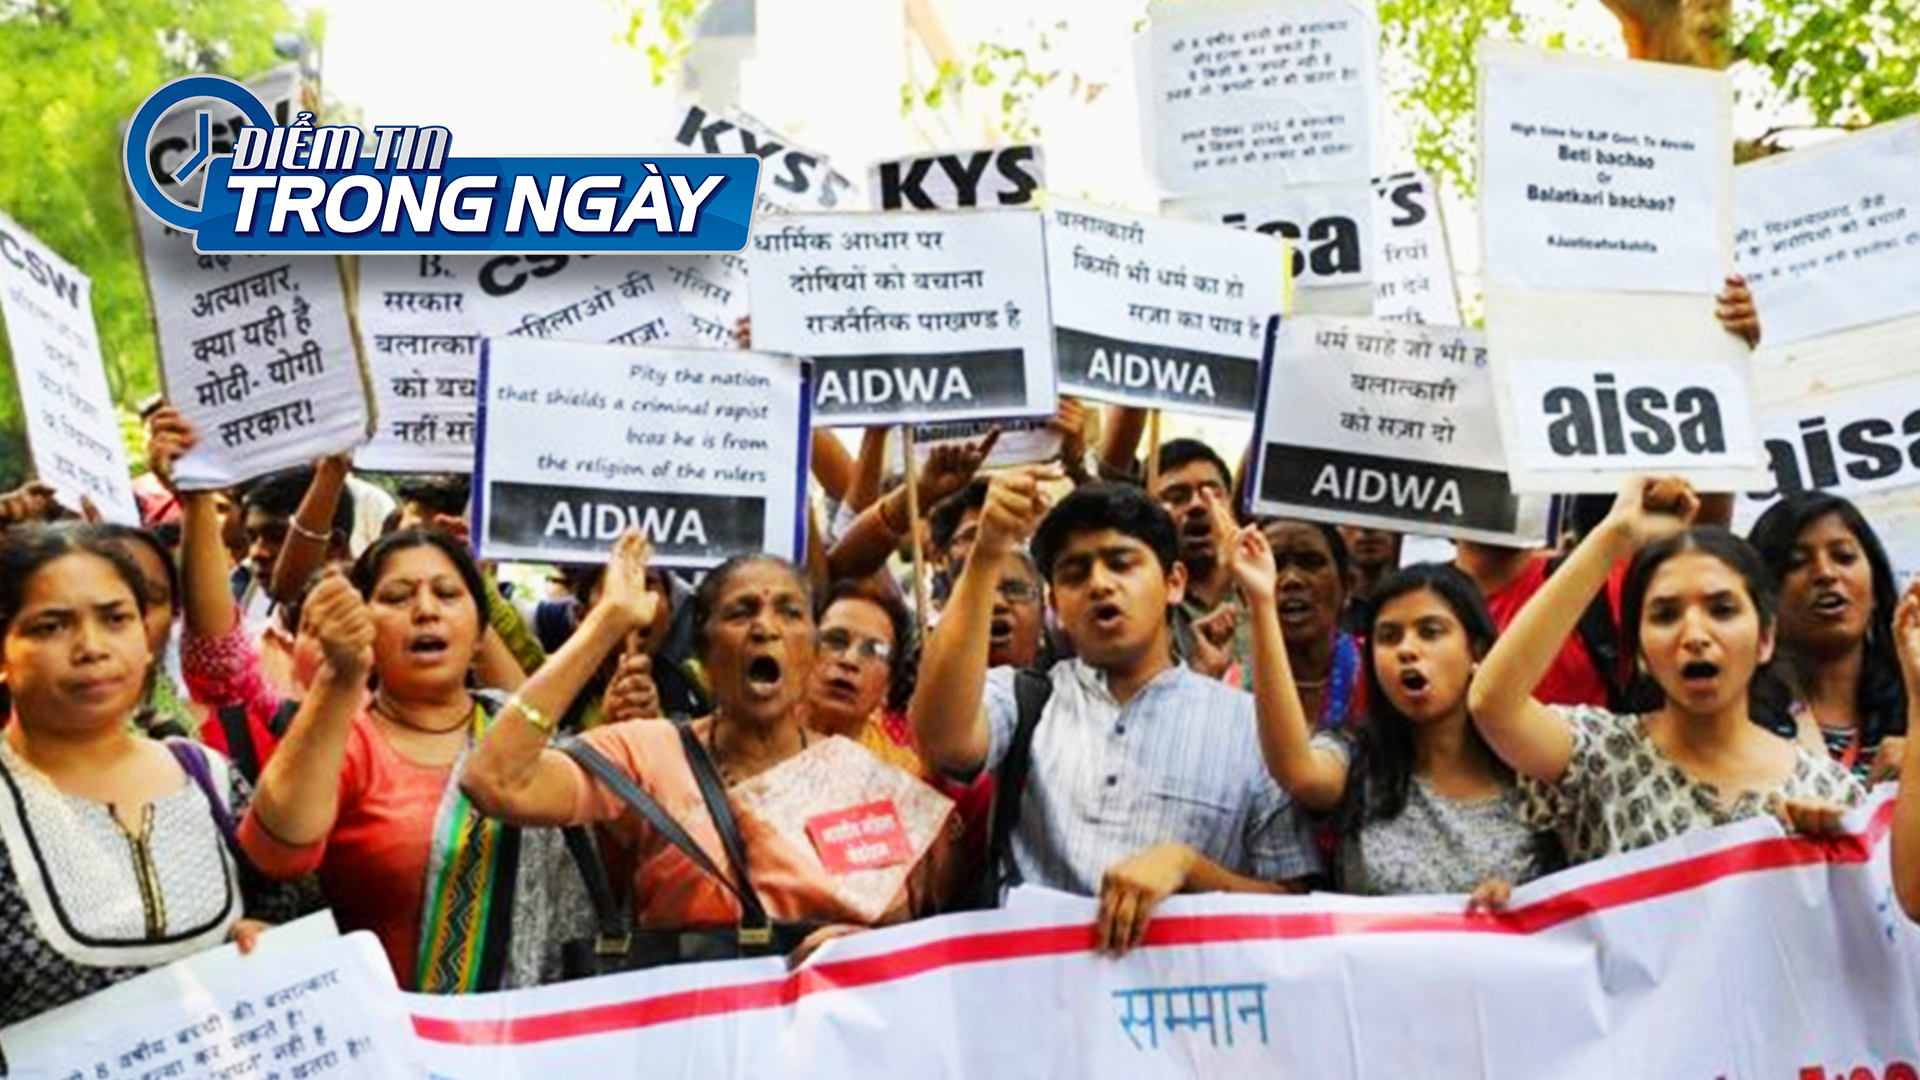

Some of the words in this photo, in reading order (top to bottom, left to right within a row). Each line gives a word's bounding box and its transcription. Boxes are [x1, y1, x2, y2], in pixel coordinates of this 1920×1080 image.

[1558, 144, 1591, 162] Beti
[1596, 149, 1654, 169] bachao
[879, 146, 1040, 210] KYS
[1527, 184, 1604, 206] Balatkari
[1608, 191, 1675, 212] bachao?
[754, 226, 831, 252] धार्मिक
[841, 231, 909, 250] आधार
[916, 231, 944, 250] पर
[0, 230, 78, 309] CSW
[619, 270, 655, 299] की
[874, 264, 905, 290] को
[913, 270, 984, 291] बचाना
[1126, 260, 1149, 284] भी
[1158, 264, 1187, 289] धर्म
[1193, 275, 1219, 295] का
[1225, 274, 1244, 298] हो
[192, 264, 299, 317] अत्याचार,
[383, 291, 465, 313] सरकार
[192, 329, 235, 362] क्या
[240, 305, 286, 346] यही
[293, 296, 311, 335] है
[806, 305, 910, 334] राजनैतिक
[1005, 301, 1022, 330] है
[1177, 310, 1203, 330] का
[374, 334, 478, 355] बलात्का
[1404, 334, 1432, 358] जो
[1439, 337, 1467, 363] भी
[1472, 346, 1488, 367] ह
[267, 340, 324, 384] योगी
[629, 365, 667, 386] Pity
[675, 367, 704, 384] the
[711, 371, 770, 387] nation
[1087, 348, 1215, 397] AIDWA
[391, 369, 428, 397] को
[816, 366, 972, 405] AIDWA
[1350, 373, 1457, 402] बलात्कारी
[497, 385, 538, 402] that
[546, 389, 606, 409] shields
[614, 399, 624, 410] a
[632, 398, 710, 417] criminal
[715, 404, 769, 422] rapist
[1542, 373, 1726, 456] aisa
[219, 399, 316, 447] सरकार!
[392, 414, 438, 445] नहीं
[673, 429, 695, 447] he
[702, 434, 715, 449] is
[722, 432, 769, 450] from
[1340, 406, 1371, 433] को
[1431, 417, 1456, 443] दो
[537, 454, 568, 471] the
[575, 456, 644, 479] religion
[652, 460, 673, 477] of
[677, 462, 705, 480] the
[714, 466, 767, 484] rulers
[1312, 463, 1465, 515] AIDWA
[544, 501, 707, 545] AIDWA
[1111, 983, 1267, 1050] सम्मान
